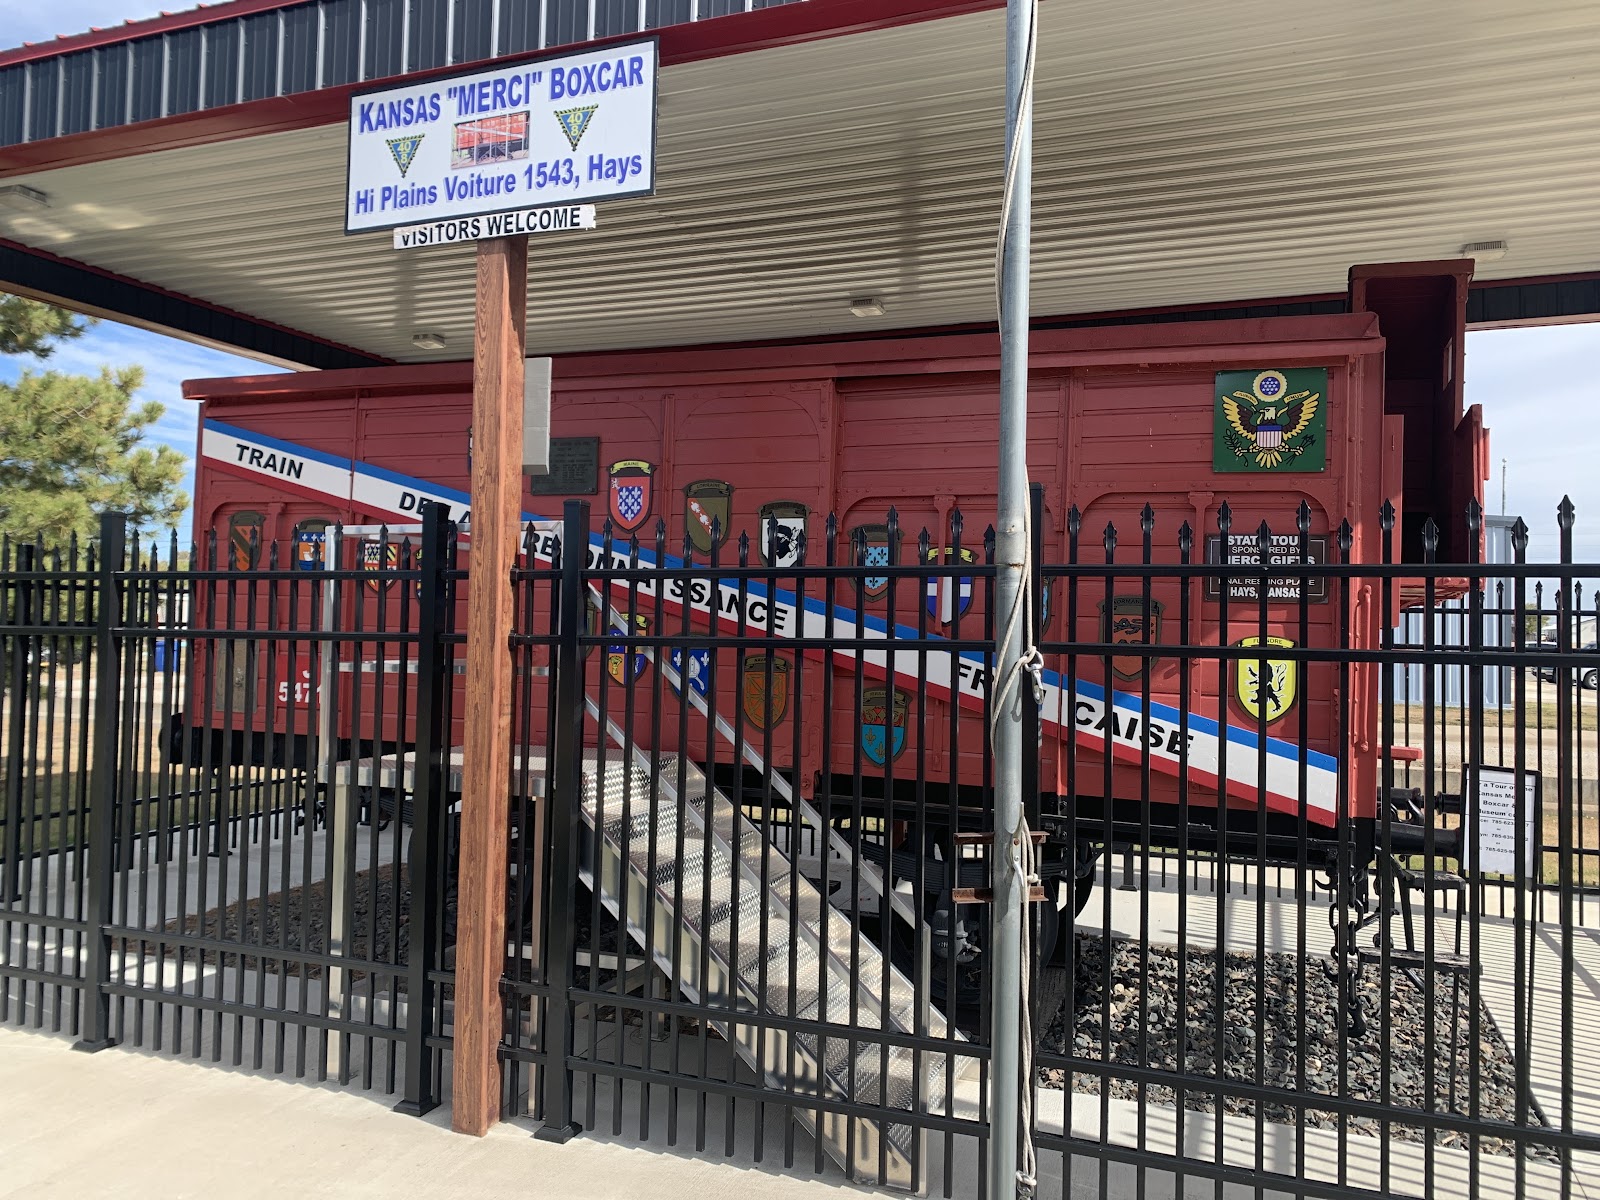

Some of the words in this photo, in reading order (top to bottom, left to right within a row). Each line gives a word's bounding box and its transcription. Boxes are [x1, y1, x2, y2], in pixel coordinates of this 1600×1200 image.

[360, 93, 440, 133] KANSAS
[449, 71, 542, 116] "MERCI"
[551, 56, 643, 100] BOXCAR
[567, 112, 583, 124] 40
[570, 125, 578, 137] 8
[356, 189, 374, 214] Hi
[382, 182, 437, 211] Plains
[444, 172, 516, 200] Voiture
[524, 158, 580, 190] 1543,
[589, 153, 642, 184] Hays
[402, 219, 481, 247] VISITORS
[487, 207, 580, 236] WELCOME
[1228, 535, 1263, 546] STAT
[1270, 535, 1301, 546] TOU
[1231, 546, 1288, 554] SPONSRED
[1219, 555, 1264, 565] ERC
[1230, 586, 1259, 599] HAYS,
[1265, 587, 1301, 598] ANSAS
[236, 443, 304, 479] TRAIN
[957, 660, 1195, 759] FRCAISE
[1491, 782, 1508, 790] Tour
[1482, 800, 1511, 808] Boxcar
